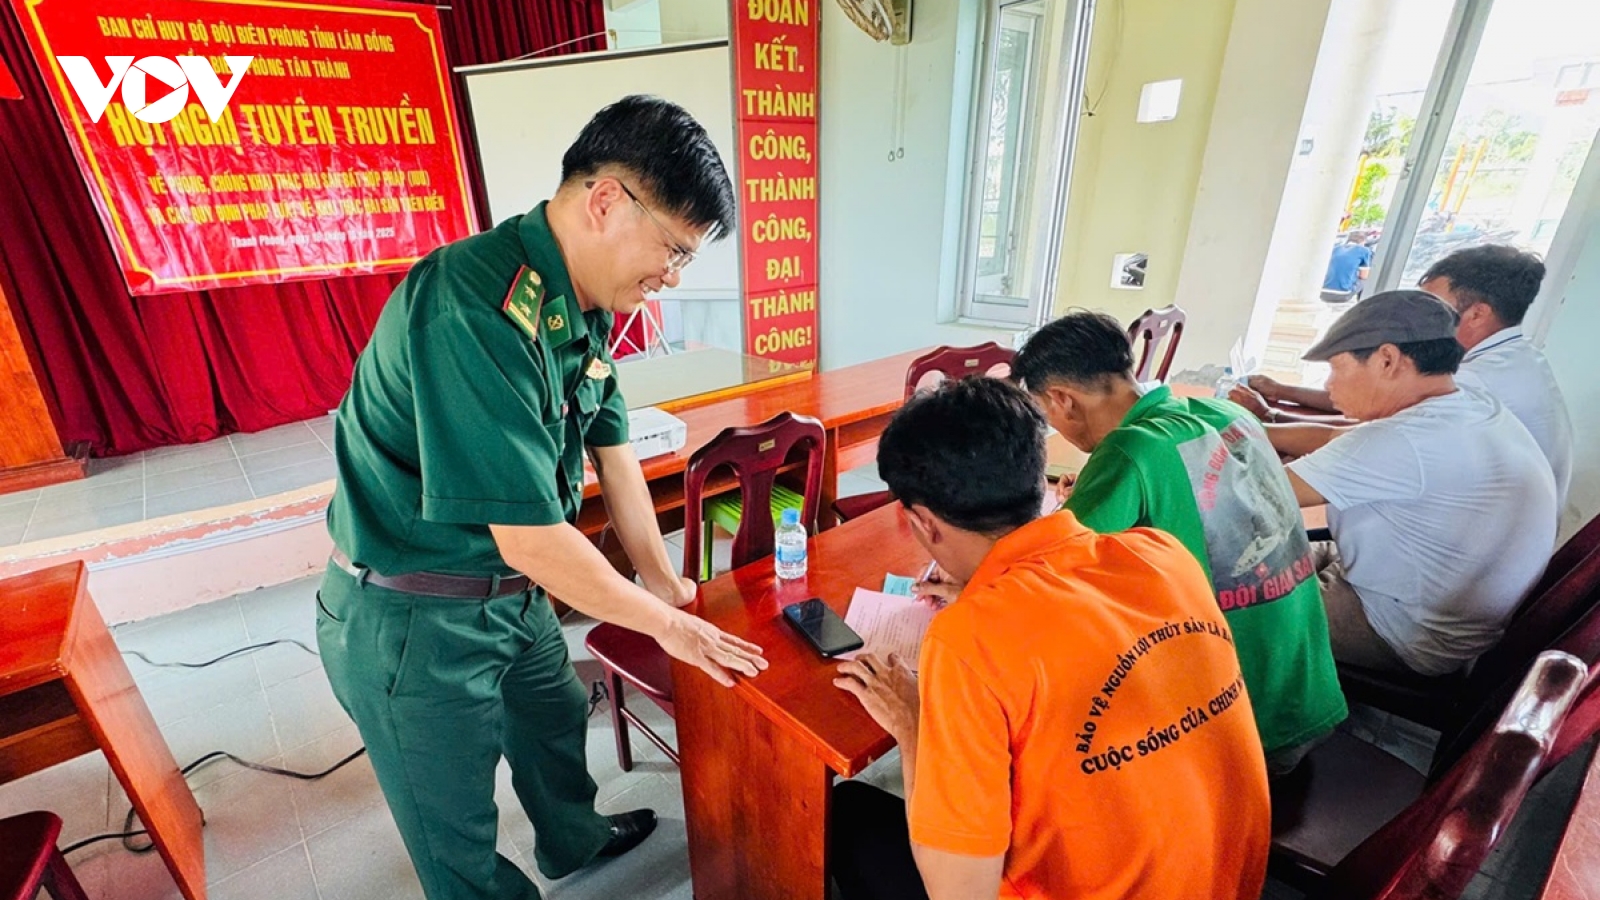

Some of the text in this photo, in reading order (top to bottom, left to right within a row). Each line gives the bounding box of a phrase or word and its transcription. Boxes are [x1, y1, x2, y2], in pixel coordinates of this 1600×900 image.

[97, 13, 395, 52] BAN CHỈ HUY BỘ ĐỘI BIÊN PHÒNG TỈNH LÂM ĐỒNG
[285, 55, 312, 77] TÂN
[311, 56, 351, 79] THÀNH
[743, 84, 815, 117] THÀNH
[240, 96, 337, 146] TUYÊN
[336, 92, 437, 145] TRUYỀN
[749, 128, 811, 164] CÔNG,
[210, 170, 249, 192] CHỐNG
[247, 174, 273, 192] KHAI
[746, 171, 815, 203] THÀNH
[190, 204, 214, 225] QUY
[752, 213, 812, 244] CÔNG,
[750, 287, 815, 320] THÀNH
[755, 326, 812, 355] CÔNG!
[1219, 583, 1257, 611] ĐỘI
[1075, 721, 1097, 754] BẢO
[1088, 696, 1111, 717] VỆ
[1101, 654, 1138, 698] NGUỒN
[1132, 637, 1152, 656] LỢI
[1148, 621, 1182, 645] THỦY
[1183, 616, 1207, 634] SẢN
[1081, 746, 1134, 774] CUỘC
[1136, 726, 1180, 757] SỐNG
[1180, 706, 1209, 733] CỦA
[1208, 682, 1239, 716] CHÍNH
